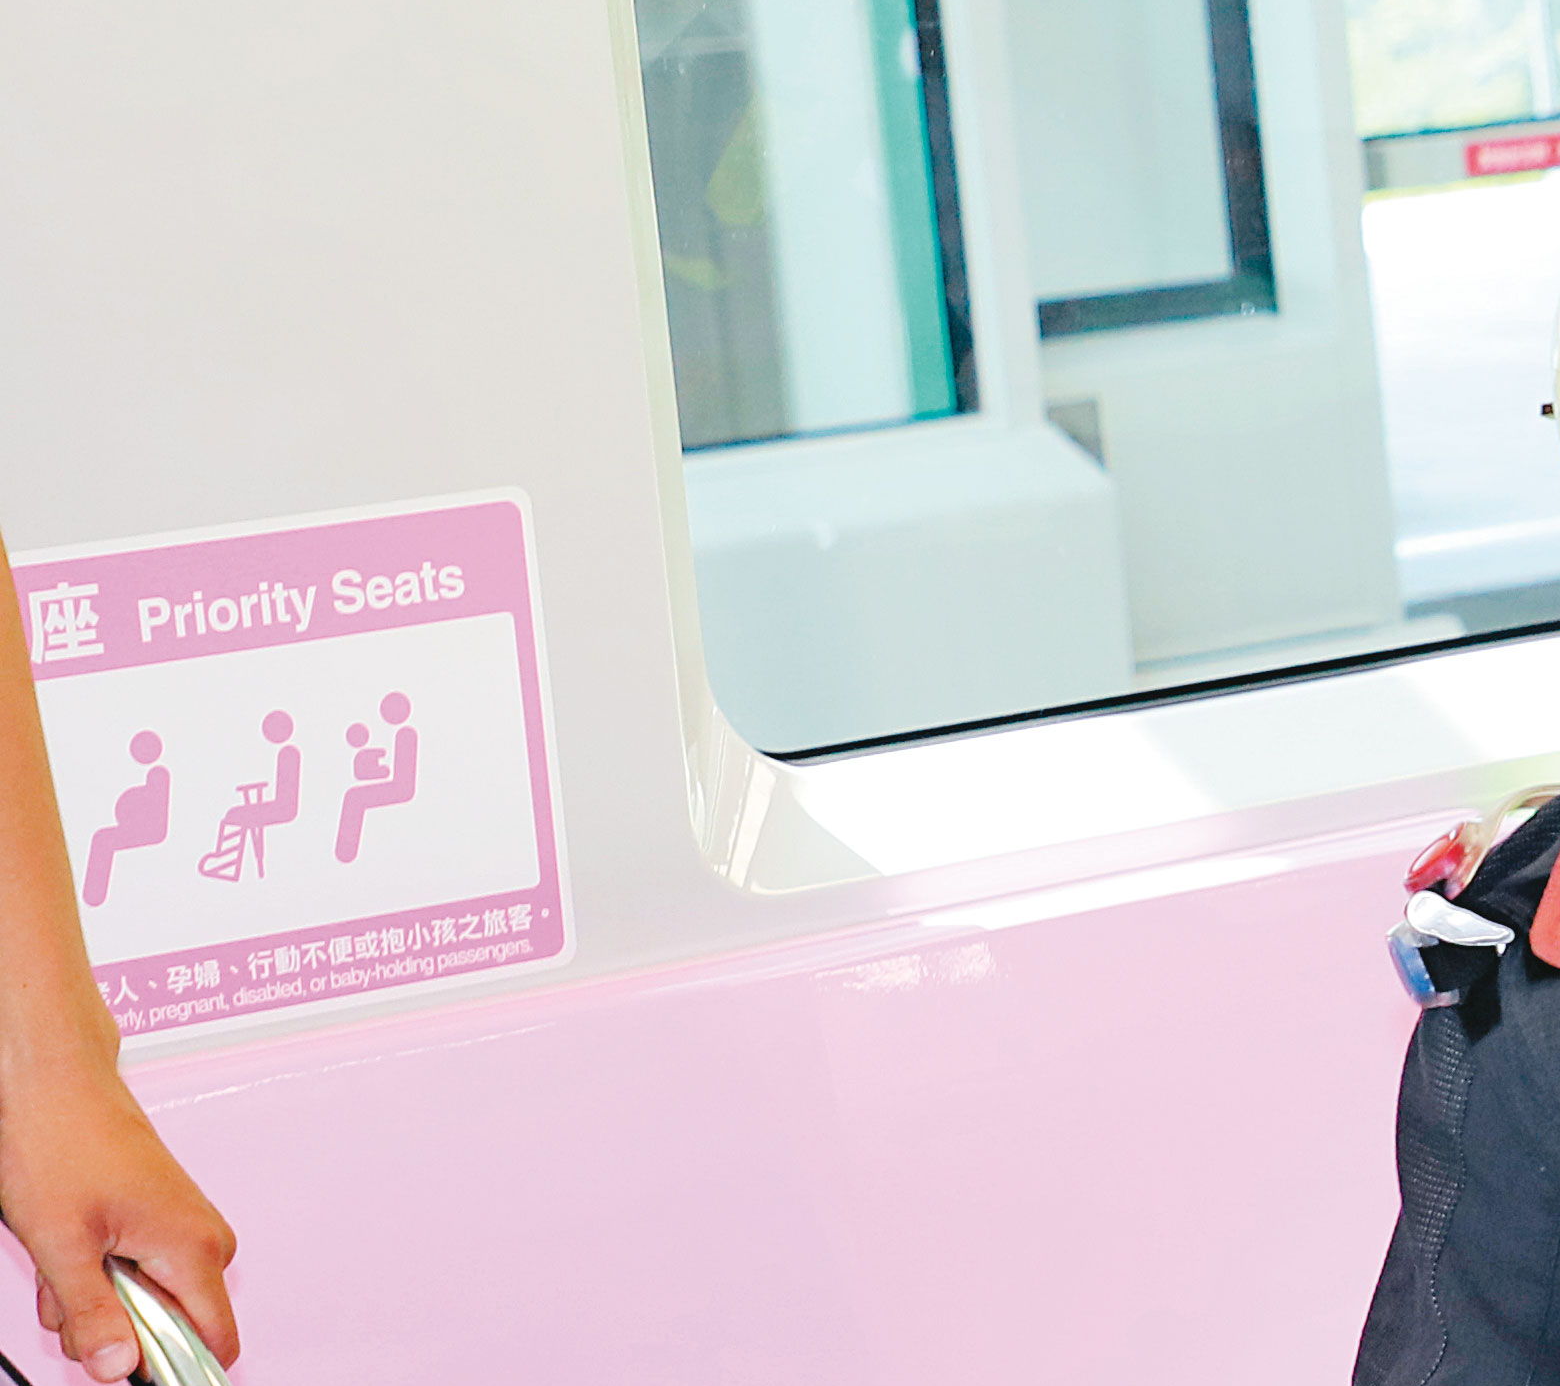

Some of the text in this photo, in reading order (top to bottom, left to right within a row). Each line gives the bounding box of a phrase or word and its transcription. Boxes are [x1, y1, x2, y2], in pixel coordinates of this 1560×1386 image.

[28, 581, 105, 664] 座
[137, 560, 466, 643] Priority Seats
[149, 994, 230, 1028] pregnant,
[232, 975, 308, 1008] disabled,
[310, 975, 328, 993] or
[330, 954, 435, 989] baby-holding
[437, 939, 534, 975] passengers.
